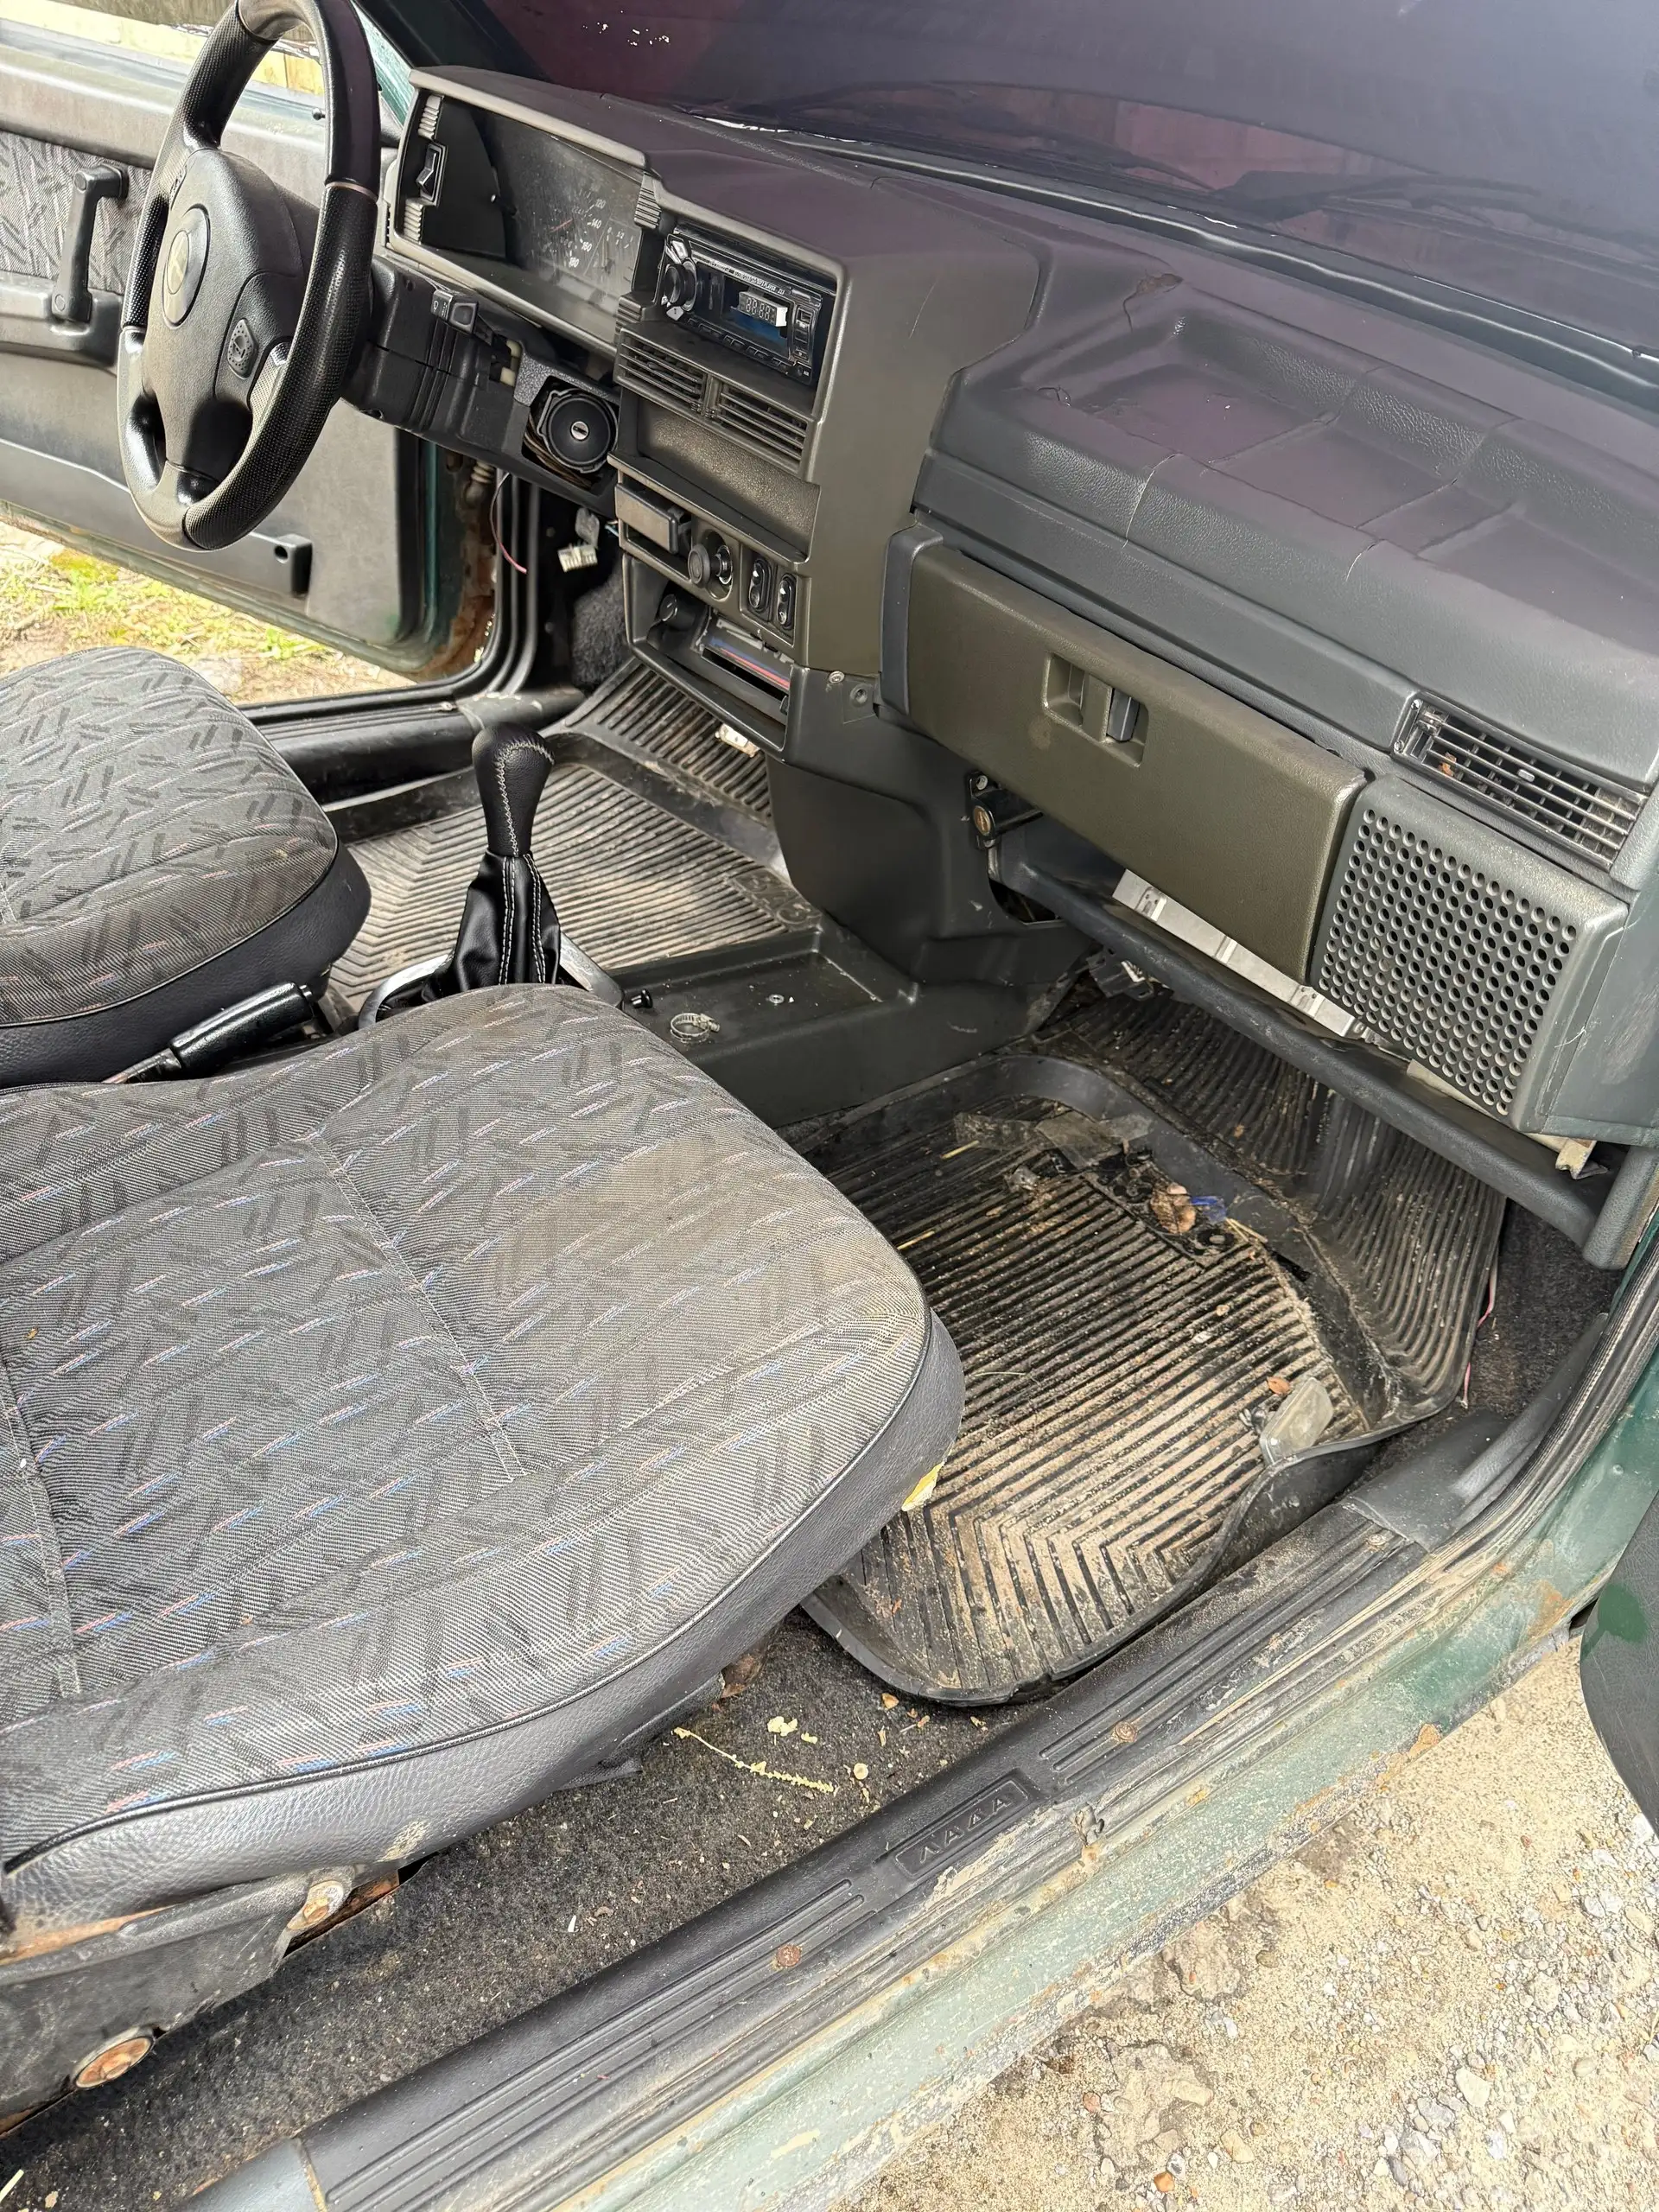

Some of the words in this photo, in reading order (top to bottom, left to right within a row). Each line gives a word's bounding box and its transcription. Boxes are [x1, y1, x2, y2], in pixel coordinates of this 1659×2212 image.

[595, 199, 606, 208] 120
[592, 219, 602, 228] 140
[582, 242, 593, 252] 160
[569, 257, 580, 268] 180
